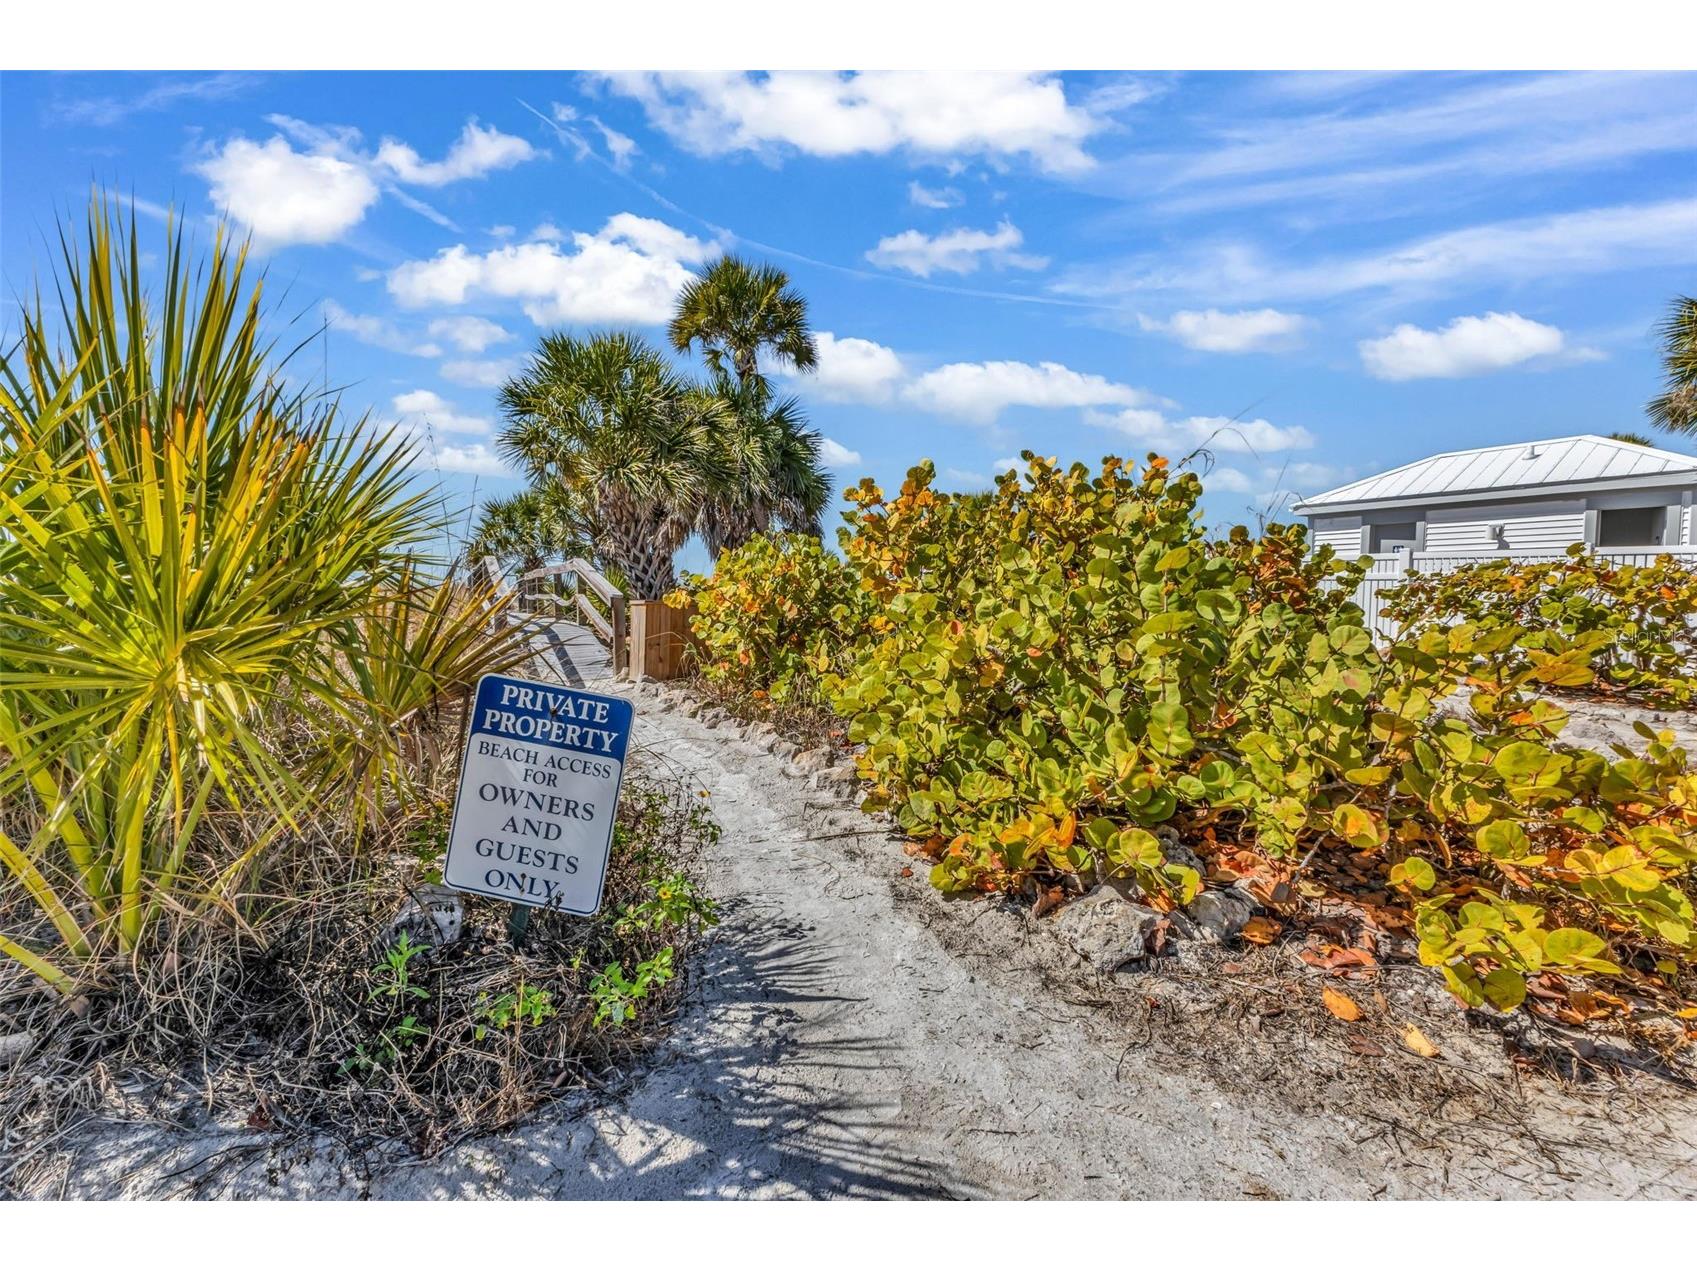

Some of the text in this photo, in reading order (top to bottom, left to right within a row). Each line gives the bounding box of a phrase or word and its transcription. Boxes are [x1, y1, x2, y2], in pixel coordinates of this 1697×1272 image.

[500, 684, 610, 724] PRIVATE
[482, 708, 618, 752] PROPERTY
[478, 741, 612, 779] BEACH ACCESS
[522, 768, 558, 788] FOR
[479, 784, 594, 821] OWNERS
[501, 816, 562, 841] AND
[476, 838, 579, 874] GUESTS
